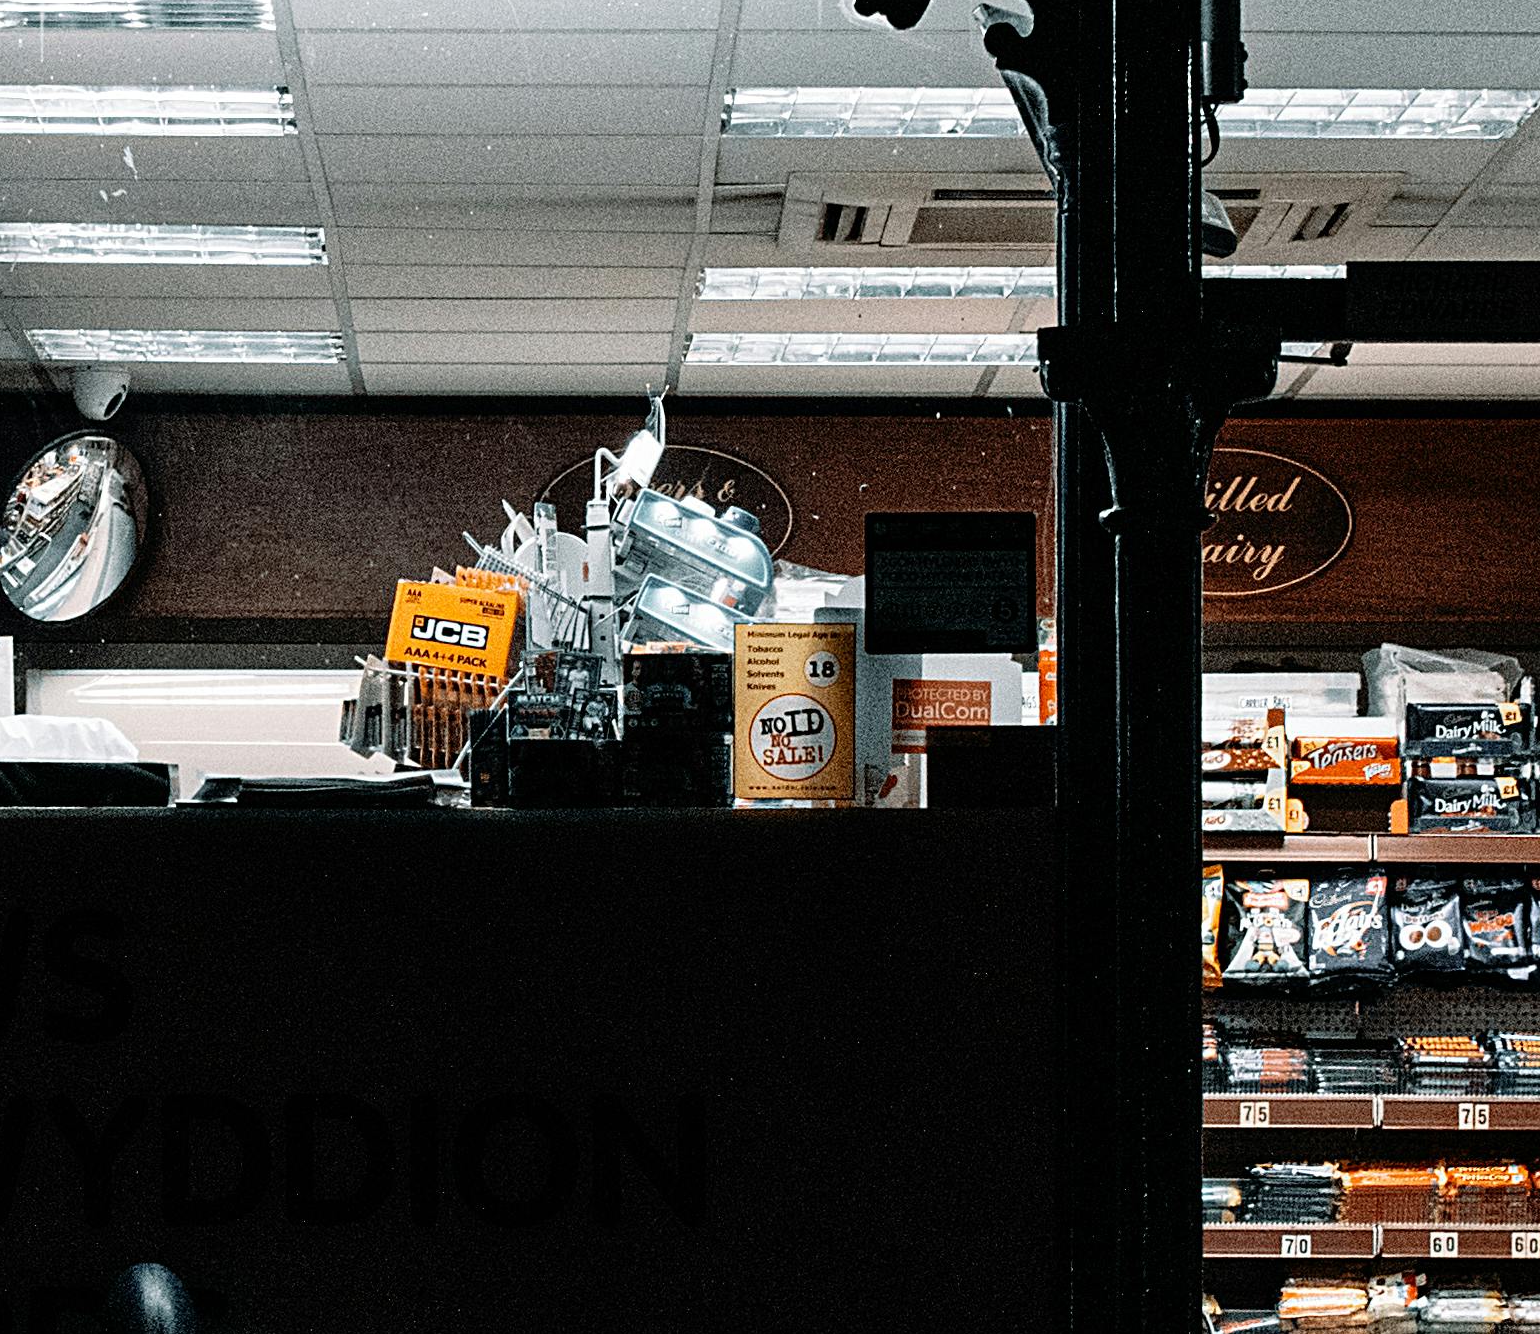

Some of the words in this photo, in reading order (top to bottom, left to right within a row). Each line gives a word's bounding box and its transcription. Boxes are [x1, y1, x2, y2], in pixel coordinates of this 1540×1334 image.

[717, 479, 736, 502] &
[1205, 475, 1301, 514] illed
[1201, 534, 1288, 583] airy
[406, 588, 422, 598] AAA
[412, 617, 488, 649] JCB
[746, 630, 786, 639] Minimum
[787, 631, 810, 640] Legal
[811, 631, 829, 640] Age
[403, 646, 430, 660] AAA
[432, 651, 455, 662] 4+4
[456, 654, 488, 668] PACK
[746, 645, 784, 654] Tobacco
[746, 657, 780, 666] Alcohol
[808, 660, 835, 679] 18
[746, 670, 785, 679] Solvents
[746, 682, 776, 691] Knives
[895, 686, 971, 702] PROTECTED
[971, 688, 990, 702] BY
[895, 700, 990, 720] DualCom
[1239, 697, 1270, 709] CARRIER
[1272, 696, 1291, 709] BAGS
[759, 716, 786, 736] NO
[783, 707, 825, 737] ID
[1503, 710, 1517, 722] £1
[1434, 724, 1472, 741] Dairy
[1472, 712, 1506, 737] Milk
[770, 734, 791, 748] NO
[1266, 734, 1280, 750] £1
[762, 744, 825, 766] SALE!
[1502, 784, 1517, 796] £1
[1267, 796, 1282, 811] £1
[1434, 798, 1472, 817] Dairy
[1472, 787, 1506, 812] Milk
[1288, 809, 1300, 821] £1
[1242, 1105, 1268, 1123] 75
[1461, 1107, 1488, 1125] 75
[1284, 1238, 1308, 1255] 70
[1433, 1236, 1455, 1253] 60
[1514, 1236, 1539, 1255] 60
